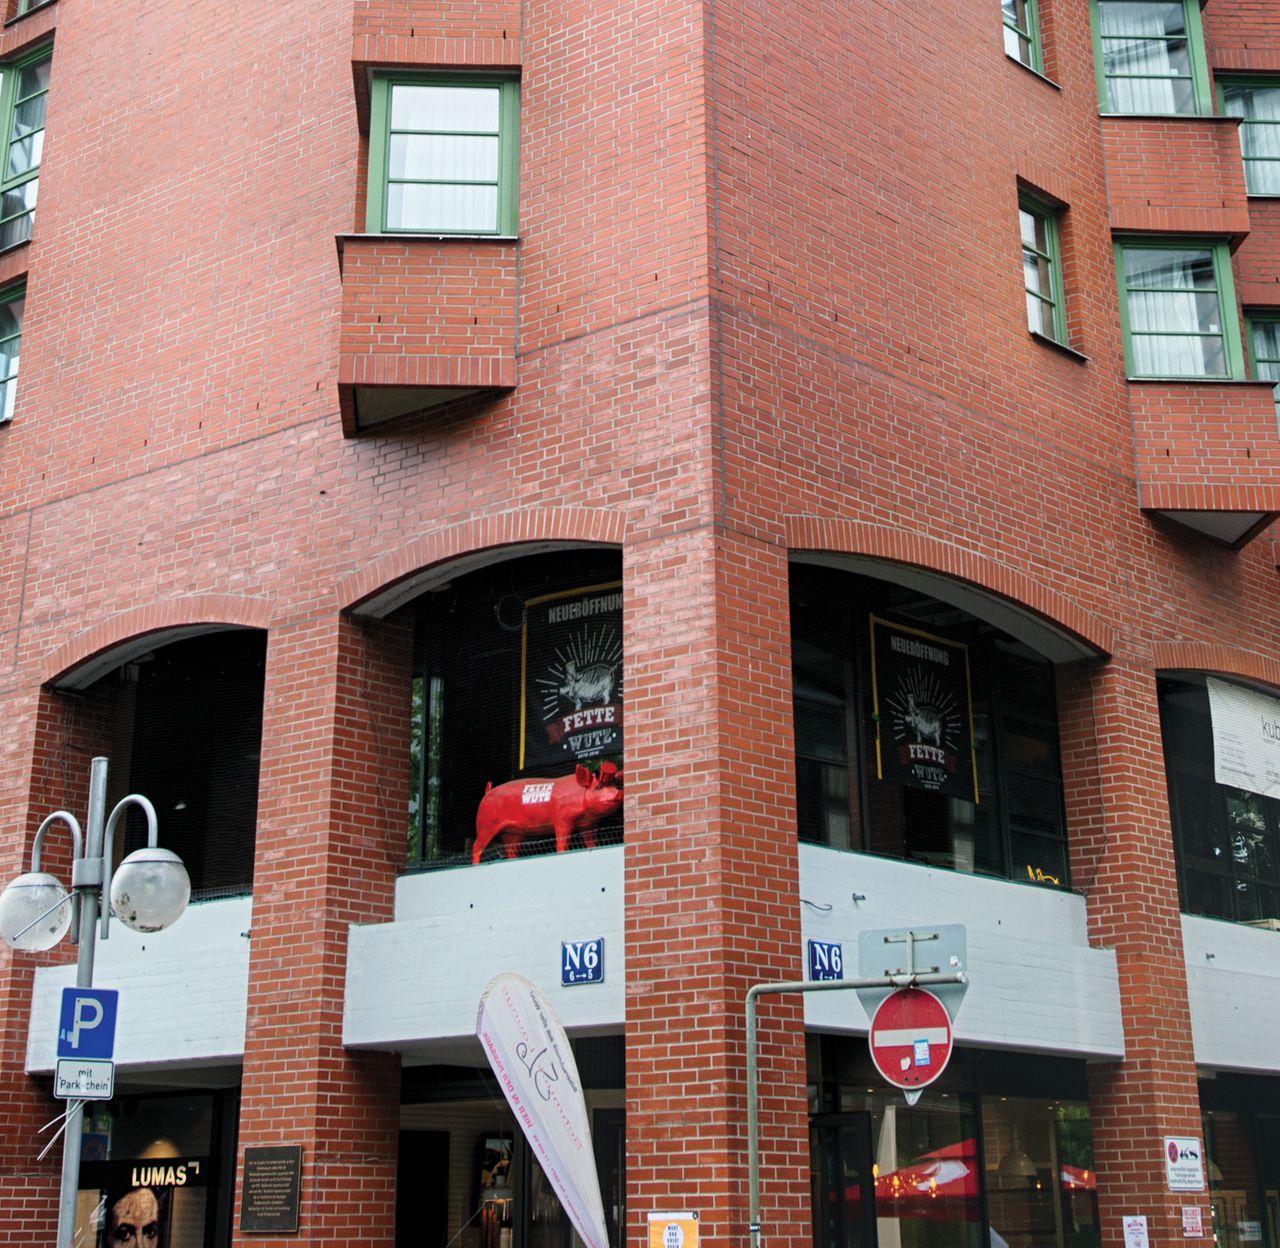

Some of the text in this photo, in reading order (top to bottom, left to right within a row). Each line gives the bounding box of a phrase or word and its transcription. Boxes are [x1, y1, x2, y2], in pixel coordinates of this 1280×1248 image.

[890, 635, 949, 666] NEUERÖFFNUNG
[563, 707, 615, 733] FETTE
[568, 728, 613, 752] WUTZ
[908, 744, 945, 764] FETTE
[913, 764, 945, 782] WUTZ
[564, 942, 598, 970] N6
[814, 943, 841, 972] N6
[71, 998, 104, 1048] P
[60, 1079, 108, 1091] Parkchein
[78, 1068, 92, 1078] mit
[132, 1165, 186, 1186] LUMAS
